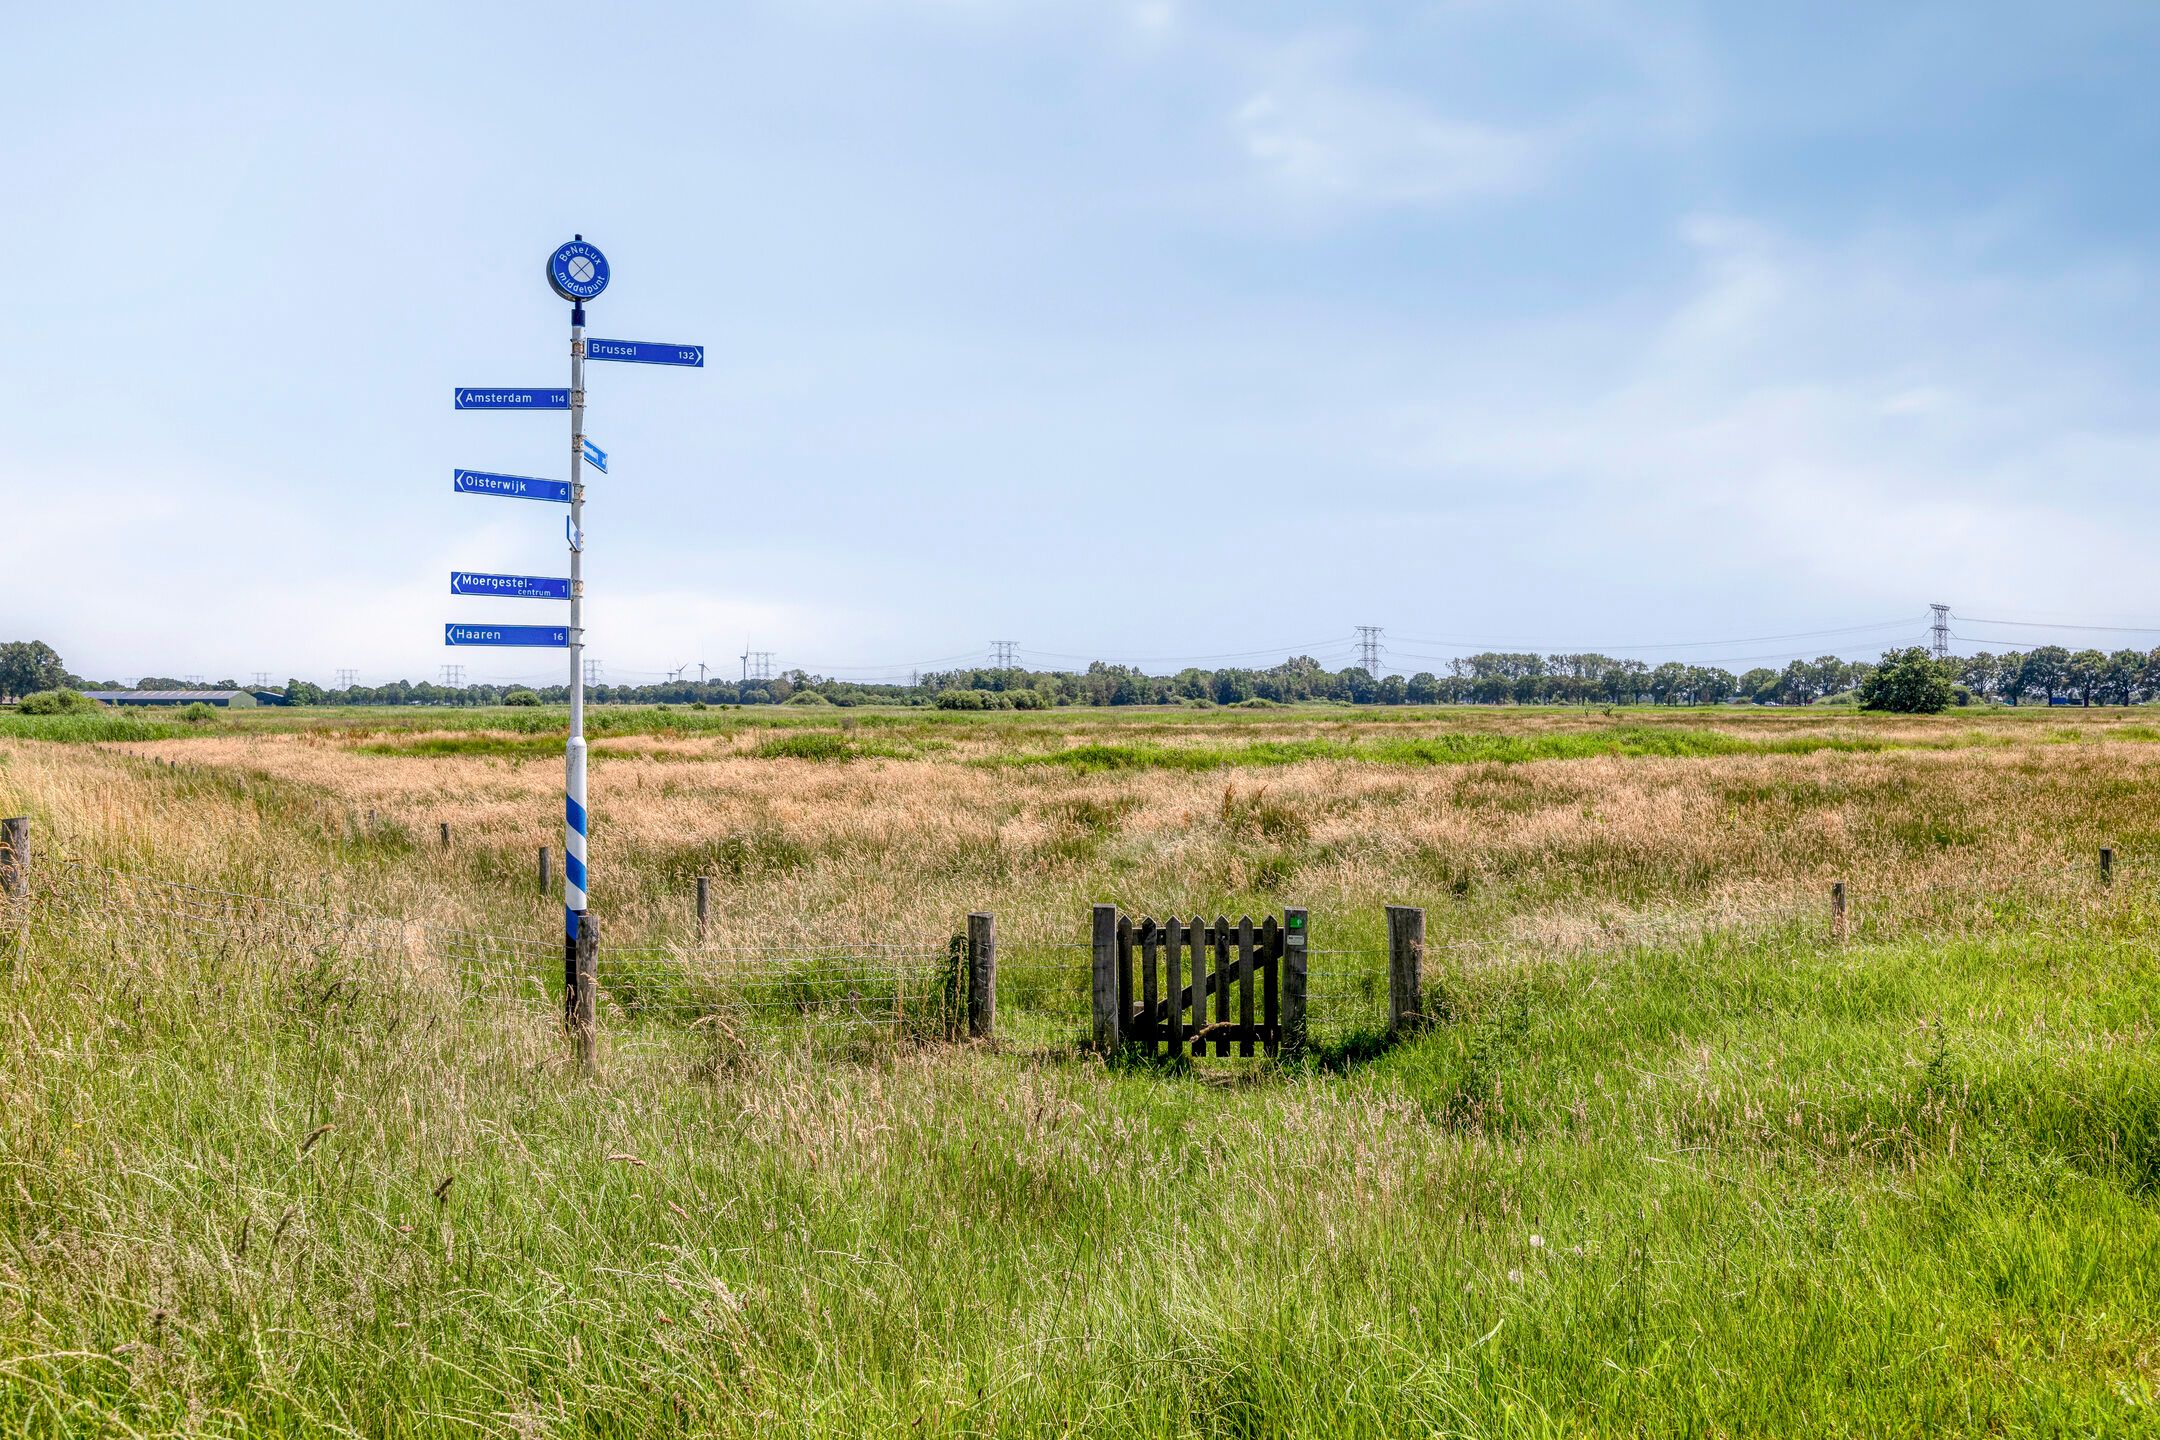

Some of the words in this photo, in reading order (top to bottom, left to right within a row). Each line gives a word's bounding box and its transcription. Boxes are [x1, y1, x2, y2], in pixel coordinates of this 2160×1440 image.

[559, 245, 602, 265] BeNeLux
[592, 343, 637, 356] Brussel
[678, 351, 695, 360] 132
[465, 392, 532, 403] Amsterdam
[551, 395, 565, 403] 114
[465, 475, 526, 493] Oisterwijk
[560, 488, 566, 496] 6
[462, 574, 533, 589] Moergestel-
[561, 585, 565, 593] 1
[517, 588, 551, 596] centrum
[456, 628, 501, 640] Haaren
[553, 632, 564, 641] 16
